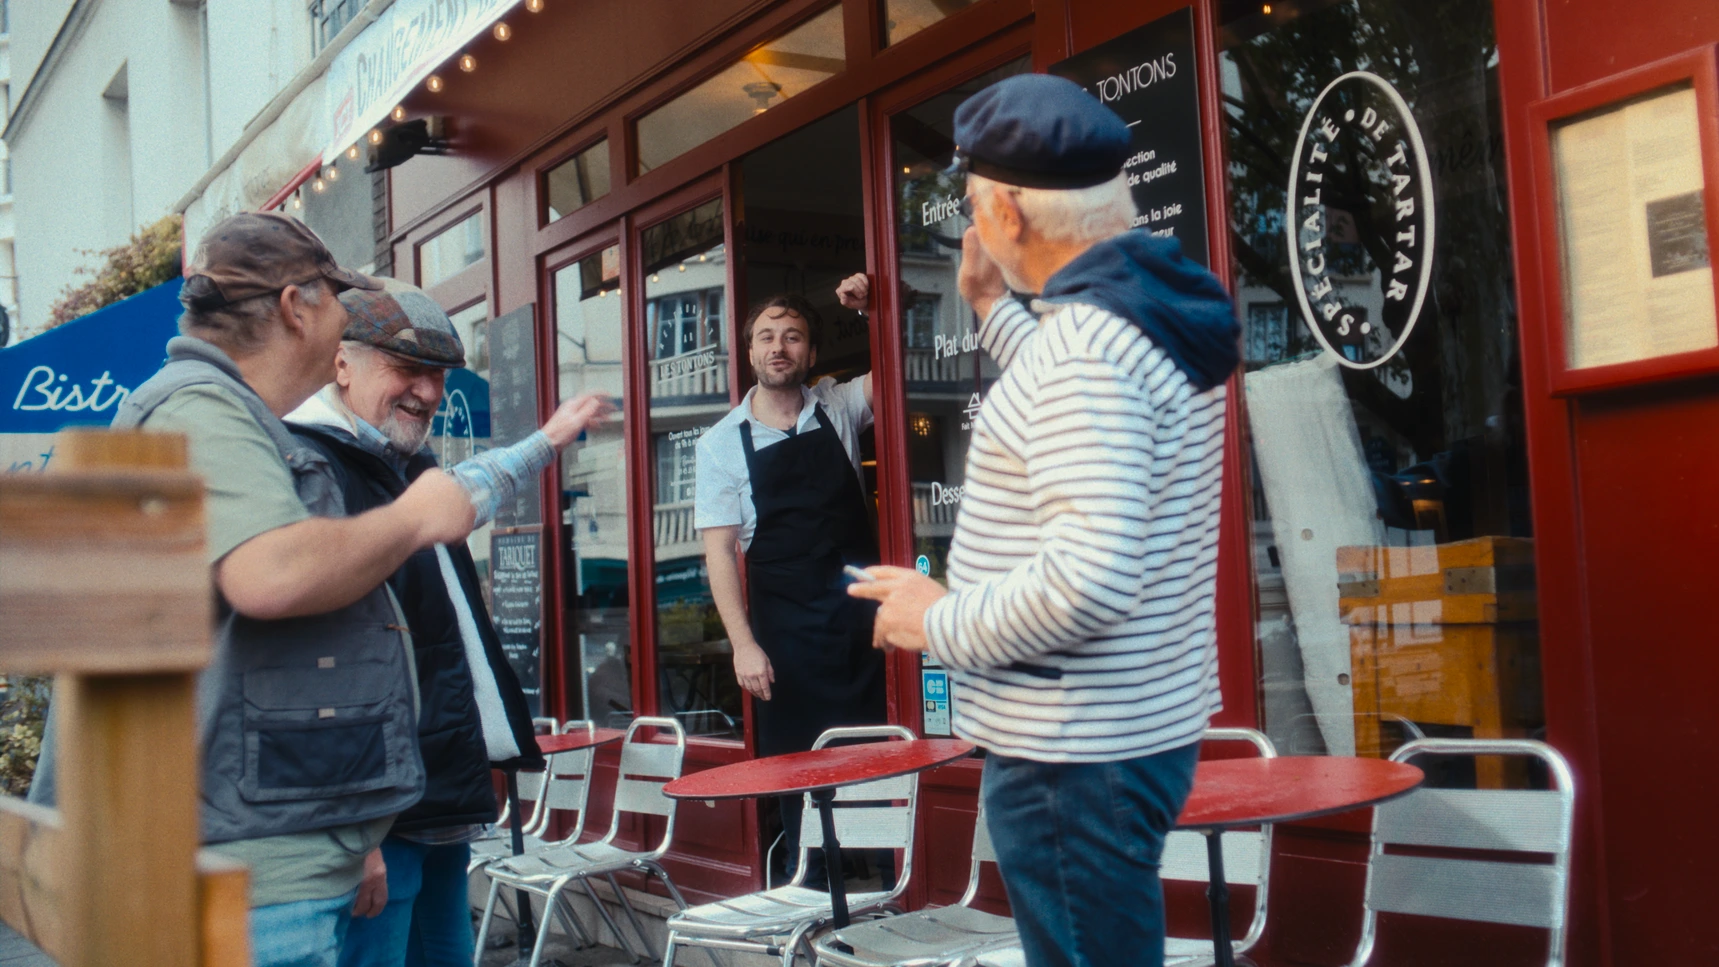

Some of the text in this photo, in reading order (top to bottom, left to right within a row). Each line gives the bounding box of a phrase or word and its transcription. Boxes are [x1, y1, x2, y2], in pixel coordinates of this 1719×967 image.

[1096, 52, 1177, 104] TONTONS
[1123, 149, 1156, 169] ection
[1127, 159, 1178, 187] de qualité
[922, 194, 961, 227] Entrée
[1130, 202, 1183, 229] ans la joie
[1303, 106, 1416, 337] SPÉCIALITÉ DE TARTAR
[934, 327, 979, 361] Plat du
